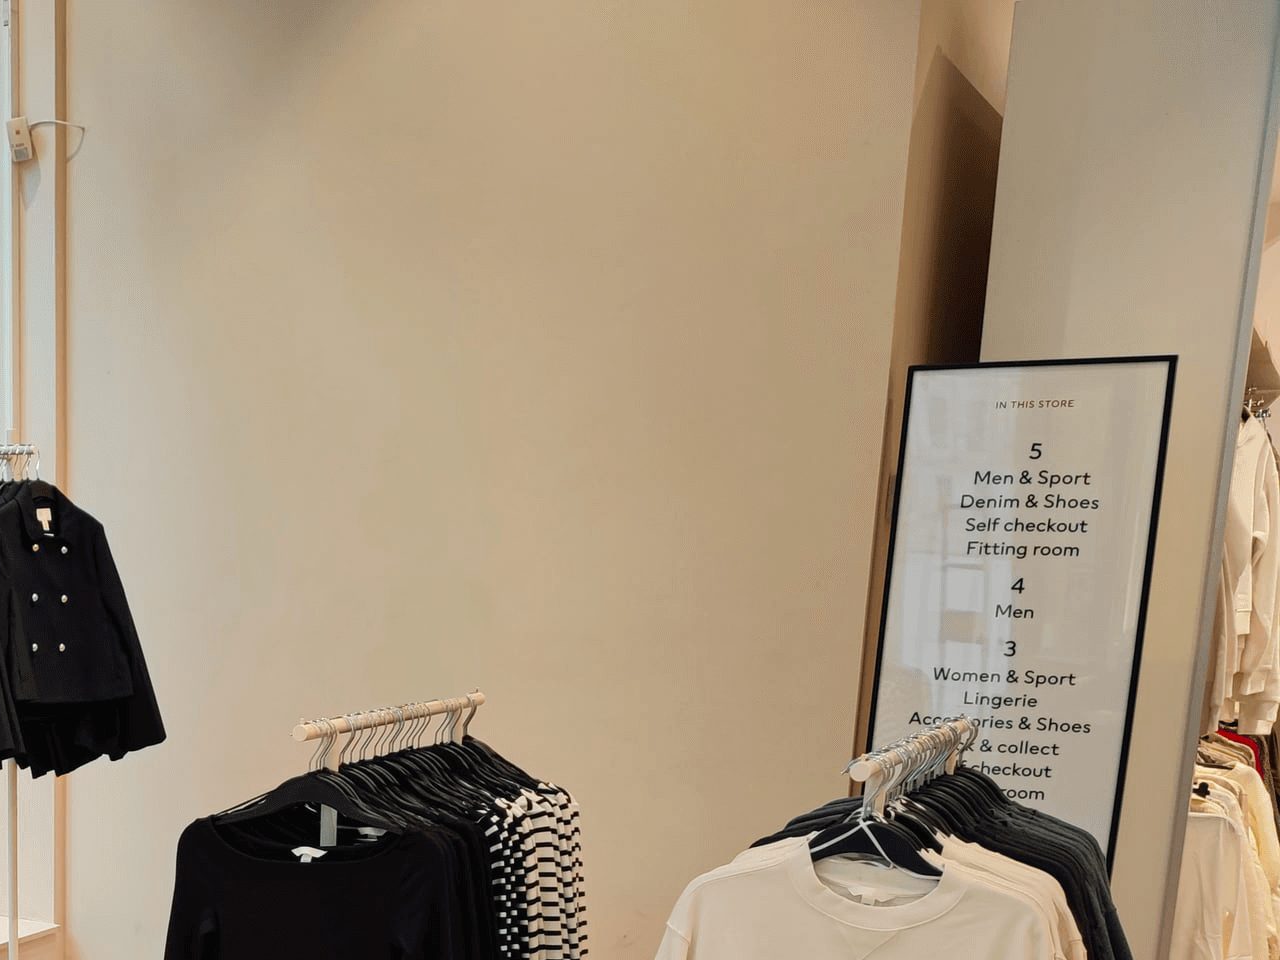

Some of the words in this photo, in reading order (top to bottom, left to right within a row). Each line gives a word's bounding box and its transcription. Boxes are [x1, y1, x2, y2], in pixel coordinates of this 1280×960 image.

[995, 400, 1007, 409] IN
[1011, 400, 1035, 409] THIS
[1038, 399, 1075, 408] STORE
[1029, 442, 1042, 460] 5
[974, 470, 1014, 485] Men
[1019, 470, 1032, 484] &
[1037, 470, 1091, 488] Sport
[960, 494, 1020, 509] Denim
[1025, 493, 1038, 508] &
[1043, 493, 1100, 509] Shoes
[965, 517, 1000, 532] Self
[1003, 517, 1088, 533] checkout
[966, 541, 1027, 559] Fitting
[1033, 545, 1080, 557] room
[1010, 577, 1025, 594] 4
[995, 604, 1034, 619] Men
[1003, 640, 1017, 657] 3
[933, 667, 1001, 683] Women
[1006, 669, 1019, 684] &
[1024, 670, 1076, 688] Sport
[963, 691, 1038, 709] Lingerie
[908, 711, 1013, 730] Accories
[1018, 716, 1031, 730] &
[1036, 717, 1091, 734] Shoes
[979, 738, 993, 753] &
[997, 740, 1060, 756] collect
